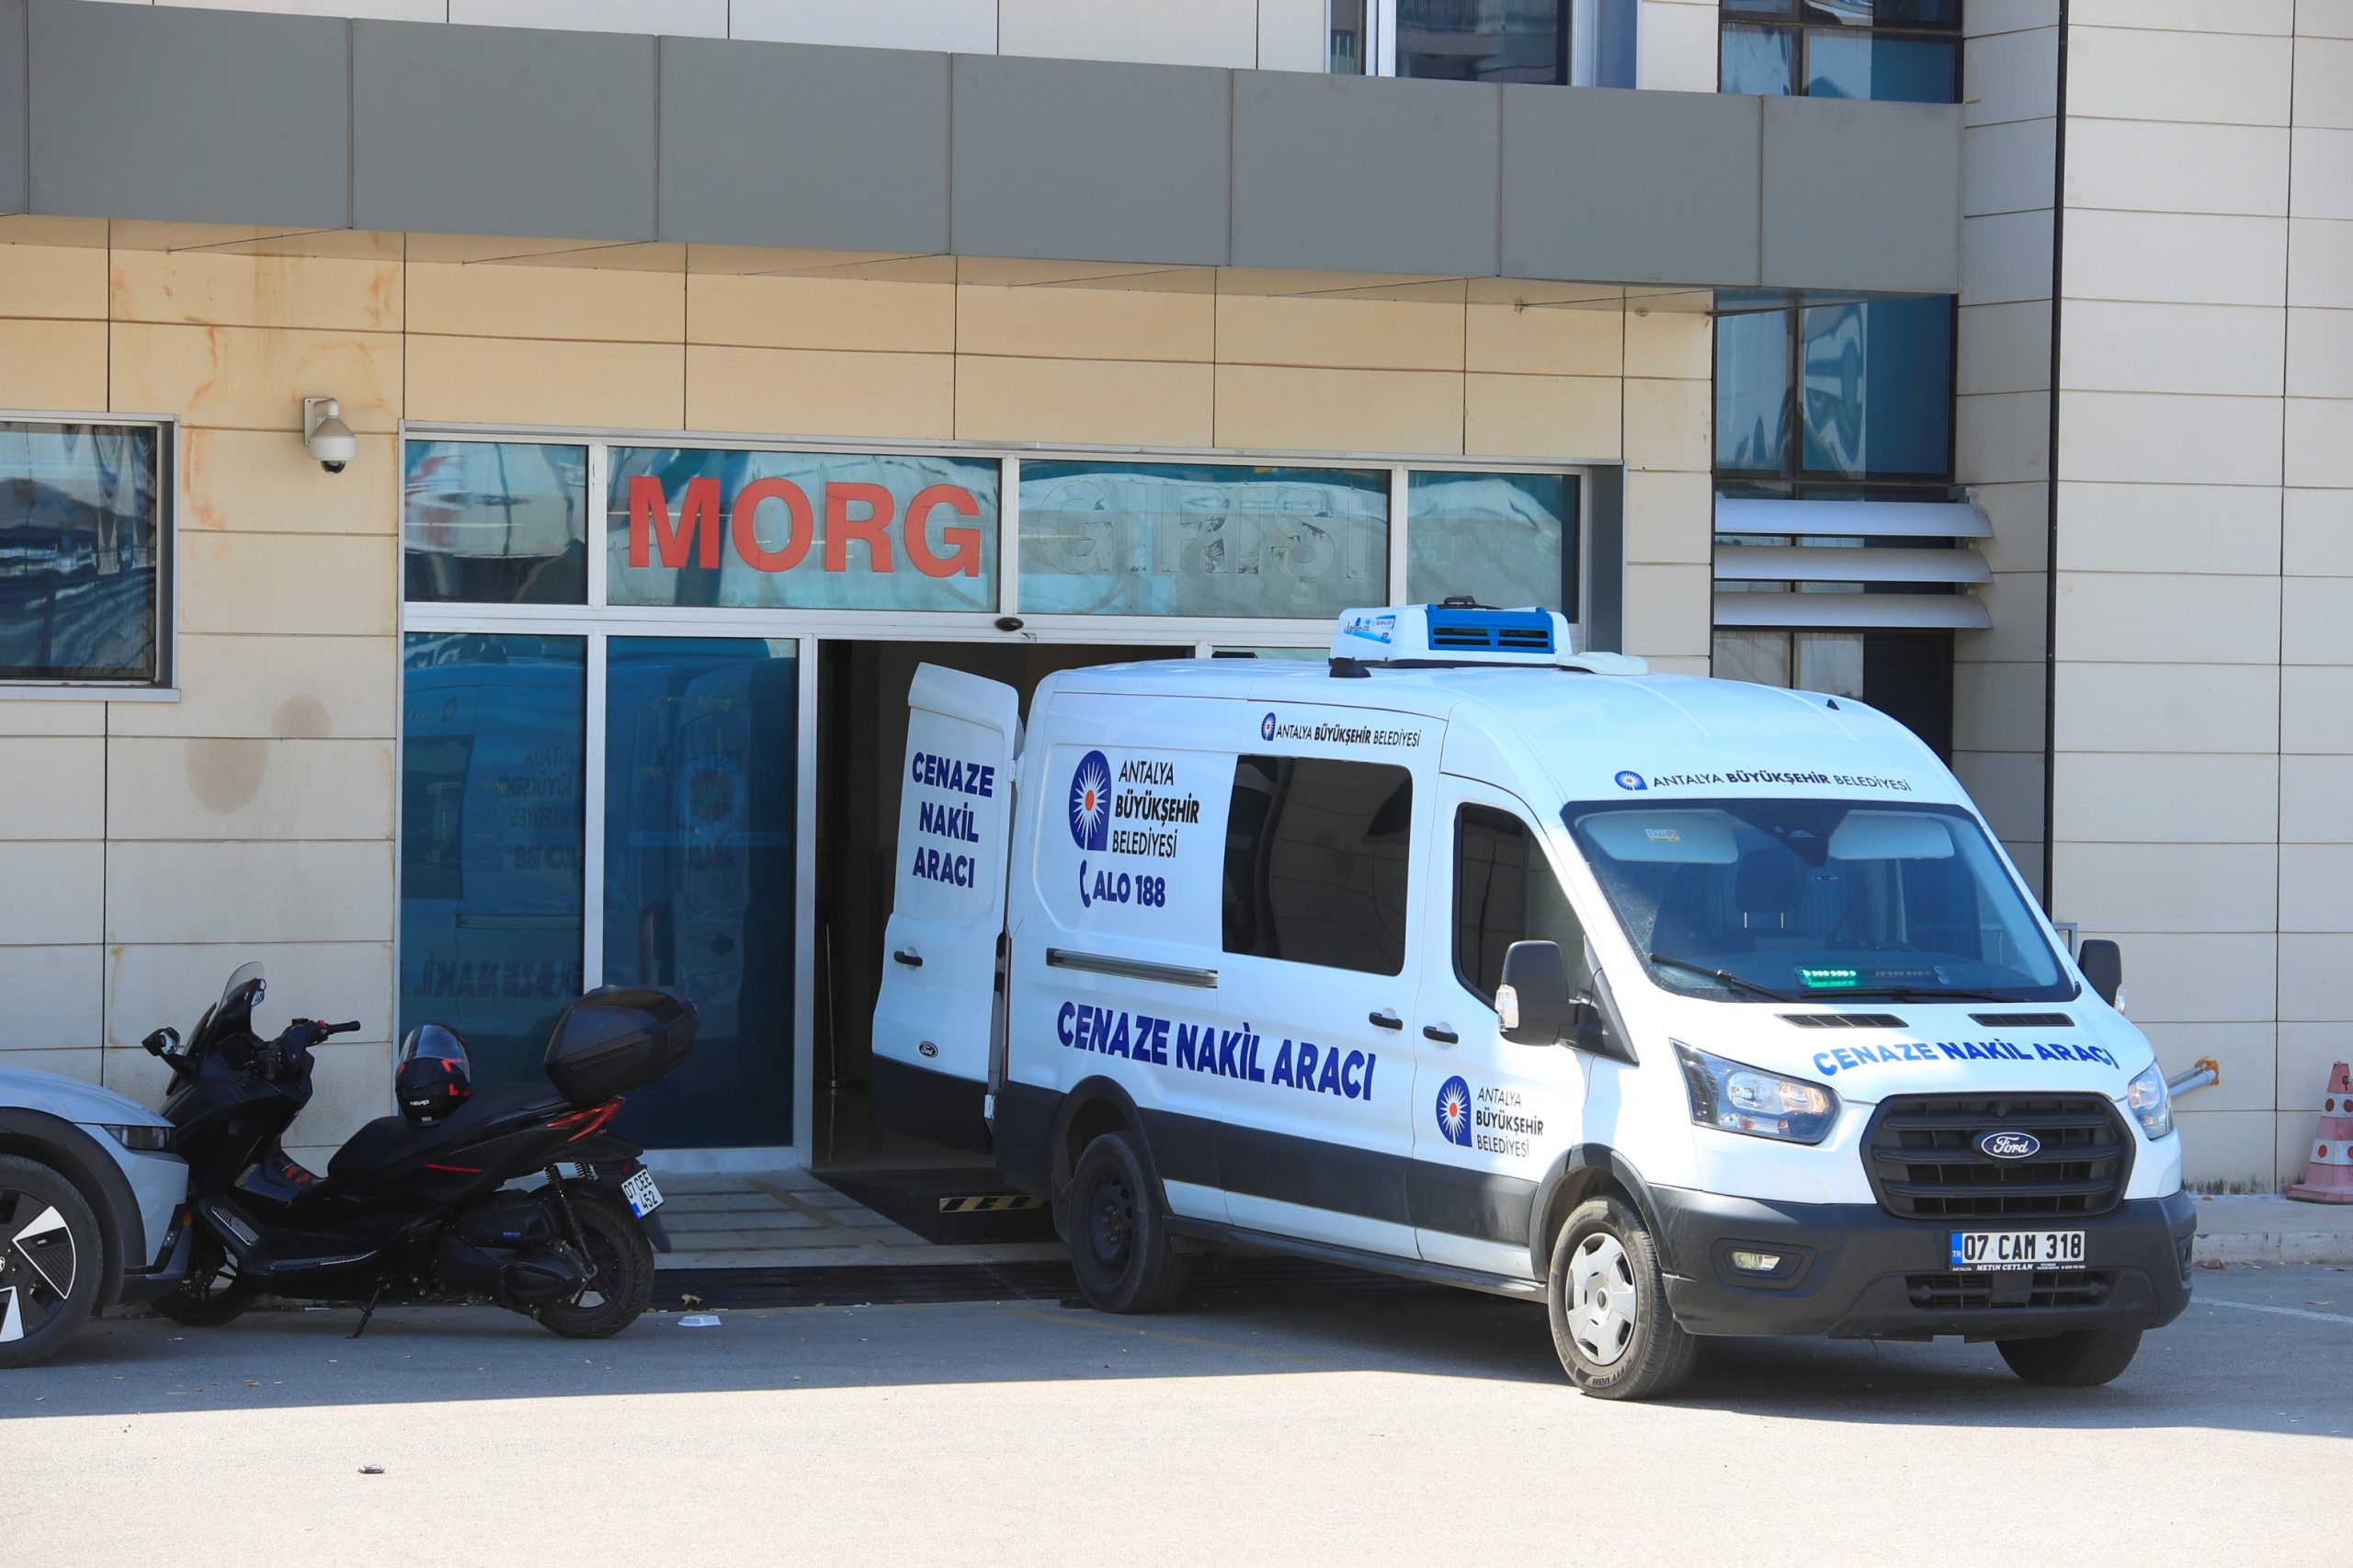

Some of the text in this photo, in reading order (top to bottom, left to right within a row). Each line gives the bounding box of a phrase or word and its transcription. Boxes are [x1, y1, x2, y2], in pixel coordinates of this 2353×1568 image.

[629, 476, 981, 578] MORG
[1276, 723, 1422, 747] ANTALYA BÜYÜKŞEHİR BELEDİYESİ
[912, 752, 995, 798] CENAZE
[1119, 759, 1175, 786] ANTALYA
[1654, 770, 1913, 792] ANTALYA BÜYÜKŞEHİR BELEDİYESİ
[919, 801, 979, 843] NAKİL
[1115, 792, 1200, 826] BÜYÜKŞEHİR
[1112, 827, 1178, 858] BELEDİYESİ
[913, 846, 975, 888] ARACI
[1092, 870, 1165, 908] ALO 188
[1057, 1001, 1377, 1101] CENAZE NAKİL ARACI
[1813, 1038, 2120, 1075] CENAZE NAKİL ARACI
[1476, 1085, 1522, 1108] ANTALYA
[1476, 1107, 1544, 1136] BÜYÜKŞEHİR
[1476, 1134, 1529, 1158] BELEDİYESİ
[1993, 1136, 2029, 1154] Ford
[623, 1171, 653, 1199] 07 CEE
[640, 1190, 658, 1210] 452
[1952, 1250, 1961, 1258] TR
[1963, 1233, 2082, 1261] 07 CAM 318
[2002, 1263, 2034, 1271] CEYLAN
